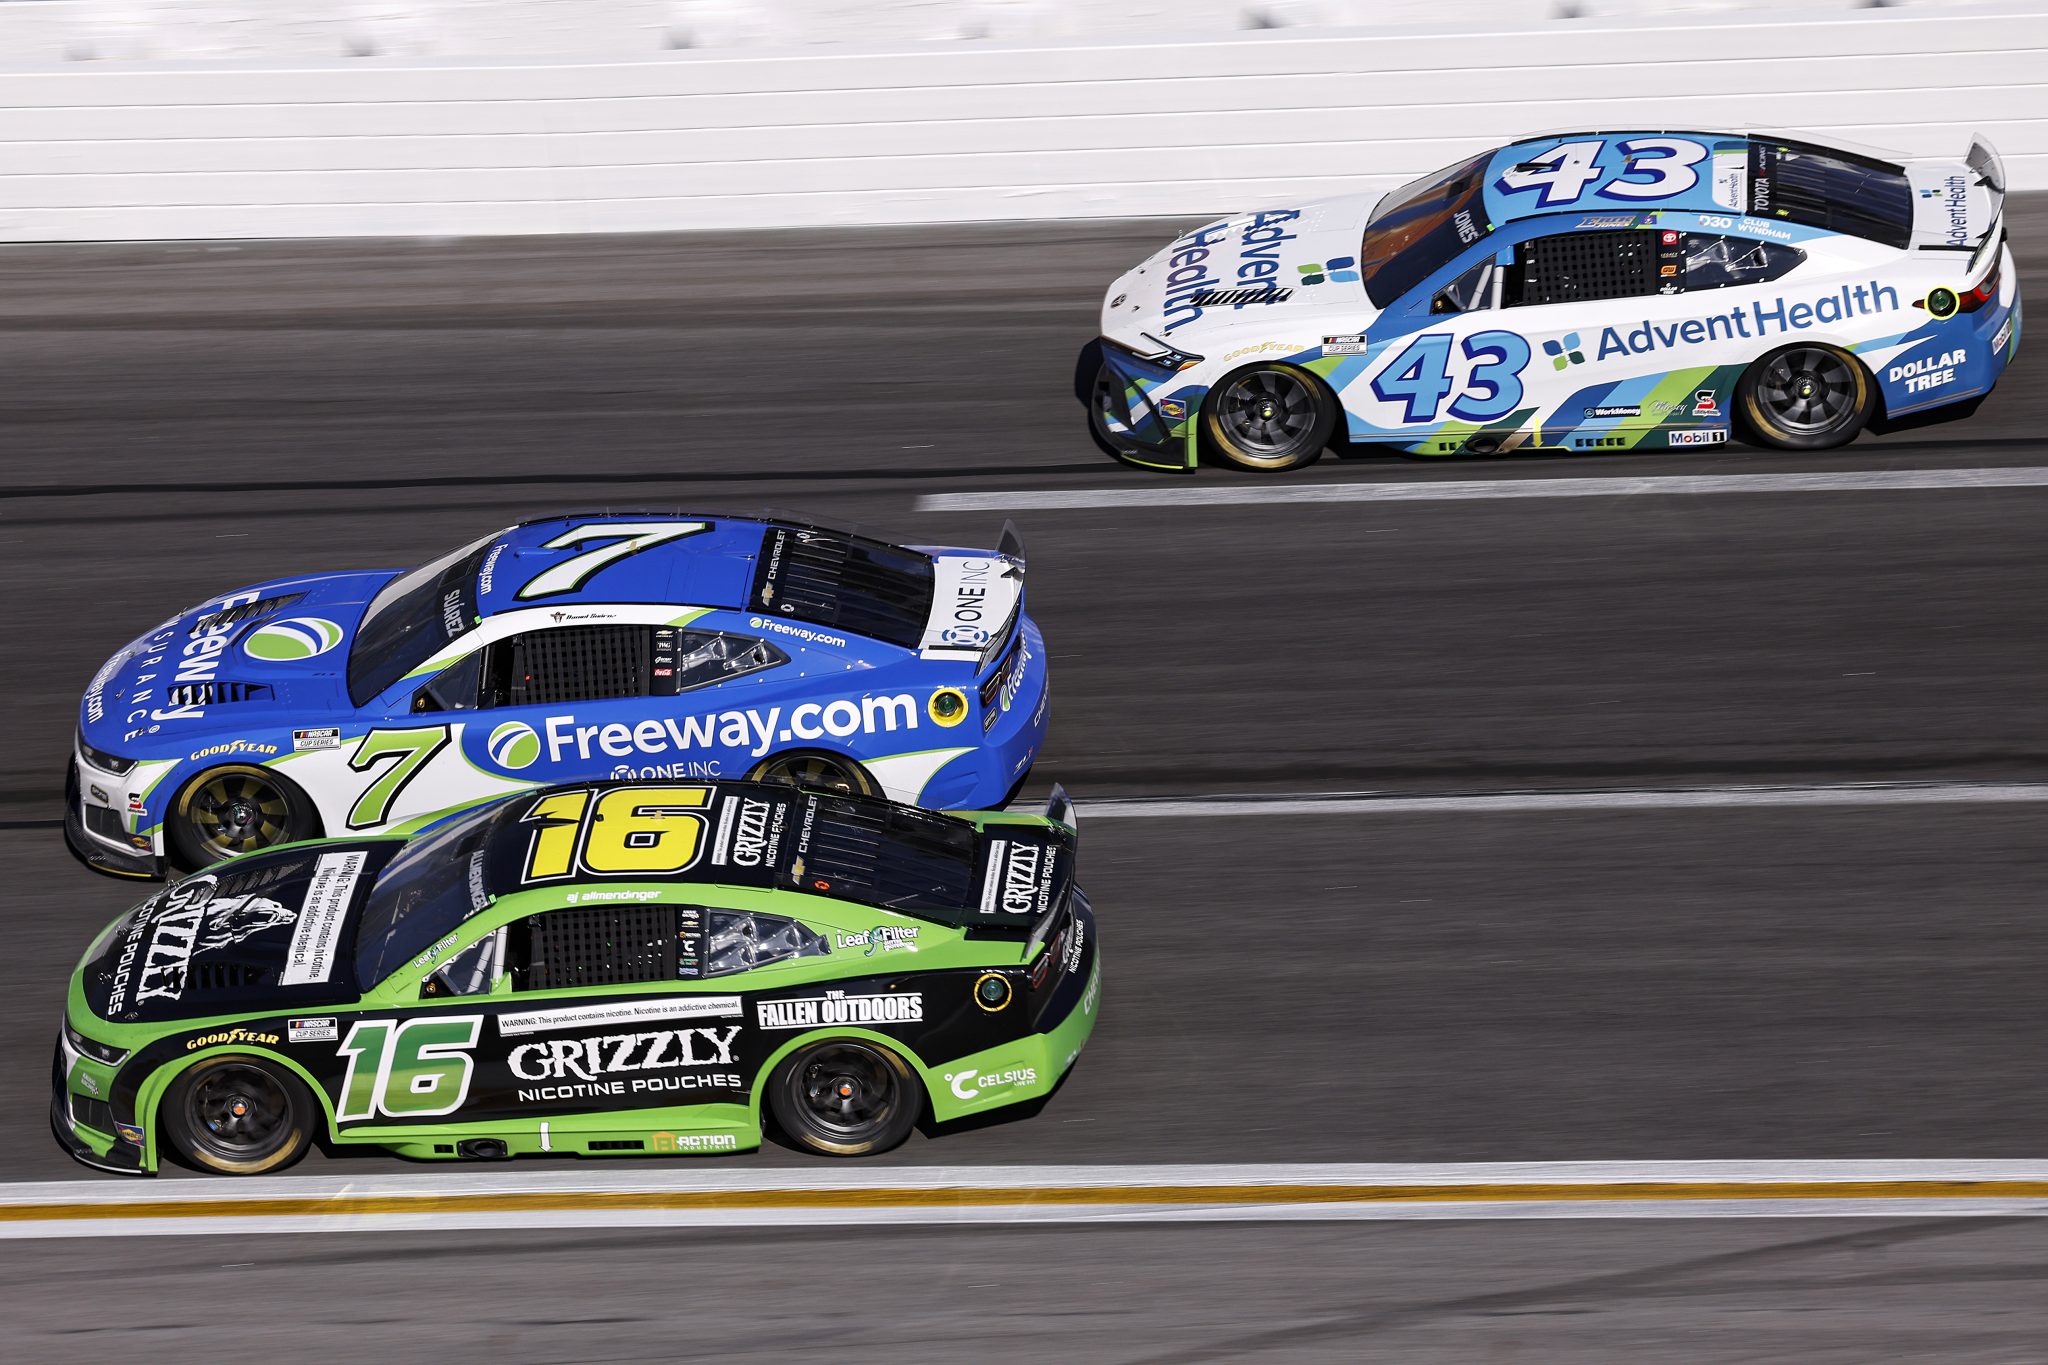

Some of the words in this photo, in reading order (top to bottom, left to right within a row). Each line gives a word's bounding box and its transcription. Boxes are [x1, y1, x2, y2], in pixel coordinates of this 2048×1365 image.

[1494, 138, 1709, 208] 43
[1754, 178, 1769, 211] TOYOTA
[1743, 218, 1770, 228] CLUB
[1944, 175, 1967, 246] AdventHealth
[1454, 209, 1478, 244] JONES
[1737, 225, 1791, 240] WYNDHAM
[1597, 280, 1899, 361] AdventHealth
[1223, 341, 1305, 361] GOODYEAR
[1889, 349, 1966, 382] DOLLAR
[1370, 329, 1531, 424] 43
[1905, 368, 1954, 394] TREE
[1595, 407, 1640, 416] WorkMoney
[1671, 432, 1709, 444] Mobil
[1713, 432, 1725, 442] 1
[480, 543, 509, 595] Freeway.com
[512, 521, 715, 601] 7
[768, 530, 786, 580] CHEVROLET
[960, 561, 990, 585] INC
[443, 588, 465, 637] SUÁREZ
[954, 587, 986, 622] ONE
[762, 619, 846, 648] Freeway.com
[150, 591, 261, 721] Feeway
[85, 649, 131, 724] Freeway.com
[124, 619, 179, 742] NSURANCE
[308, 730, 333, 738] NASCAR
[314, 738, 334, 746] SERIES
[544, 692, 919, 762] Freeway.com
[191, 740, 277, 761] GOODYEAR
[347, 723, 452, 831] 7
[640, 762, 685, 778] ONE
[688, 760, 721, 778] INC
[519, 785, 717, 884] 16
[733, 797, 770, 867] GRIZZLY
[798, 795, 818, 854] CHEVROLET
[765, 832, 780, 867] NICOTINE
[1042, 845, 1057, 879] POUCHES
[332, 884, 349, 898] This
[1002, 841, 1039, 914] GRIZZLY
[310, 896, 322, 905] an
[325, 898, 340, 921] product
[566, 892, 578, 903] aj
[582, 890, 662, 901] allmendinger
[1037, 879, 1052, 913] NICOTINE
[300, 905, 321, 934] addictive
[315, 921, 333, 948] contains
[293, 934, 312, 968] chemical.
[836, 930, 870, 949] Leaf
[881, 926, 920, 941] Filter
[309, 948, 328, 980] nicotine.
[1068, 944, 1082, 974] NICOTINE
[108, 943, 138, 1016] POUCHES
[825, 990, 845, 1000] THE
[304, 1019, 330, 1028] NASCAR
[501, 1017, 537, 1028] WARNING:
[538, 1016, 552, 1024] This
[553, 1014, 577, 1025] product
[578, 1012, 605, 1020] contains
[606, 1009, 633, 1018] nicotine.
[634, 1006, 661, 1015] Nicotine
[678, 1002, 707, 1011] addictive
[708, 1000, 738, 1009] chemical.
[760, 1001, 820, 1026] FALLEN
[822, 996, 922, 1023] OUTDOORS
[187, 1028, 279, 1050] GOODYEAR
[296, 1030, 308, 1038] CUP
[310, 1029, 331, 1037] SERIES
[336, 1014, 484, 1122] 16
[507, 1026, 742, 1081] GRIZZLY
[518, 1081, 625, 1102] NICOTINE
[632, 1075, 741, 1093] POUCHES
[977, 1068, 1036, 1088] CELSIUS
[677, 1134, 736, 1146] ACTION
